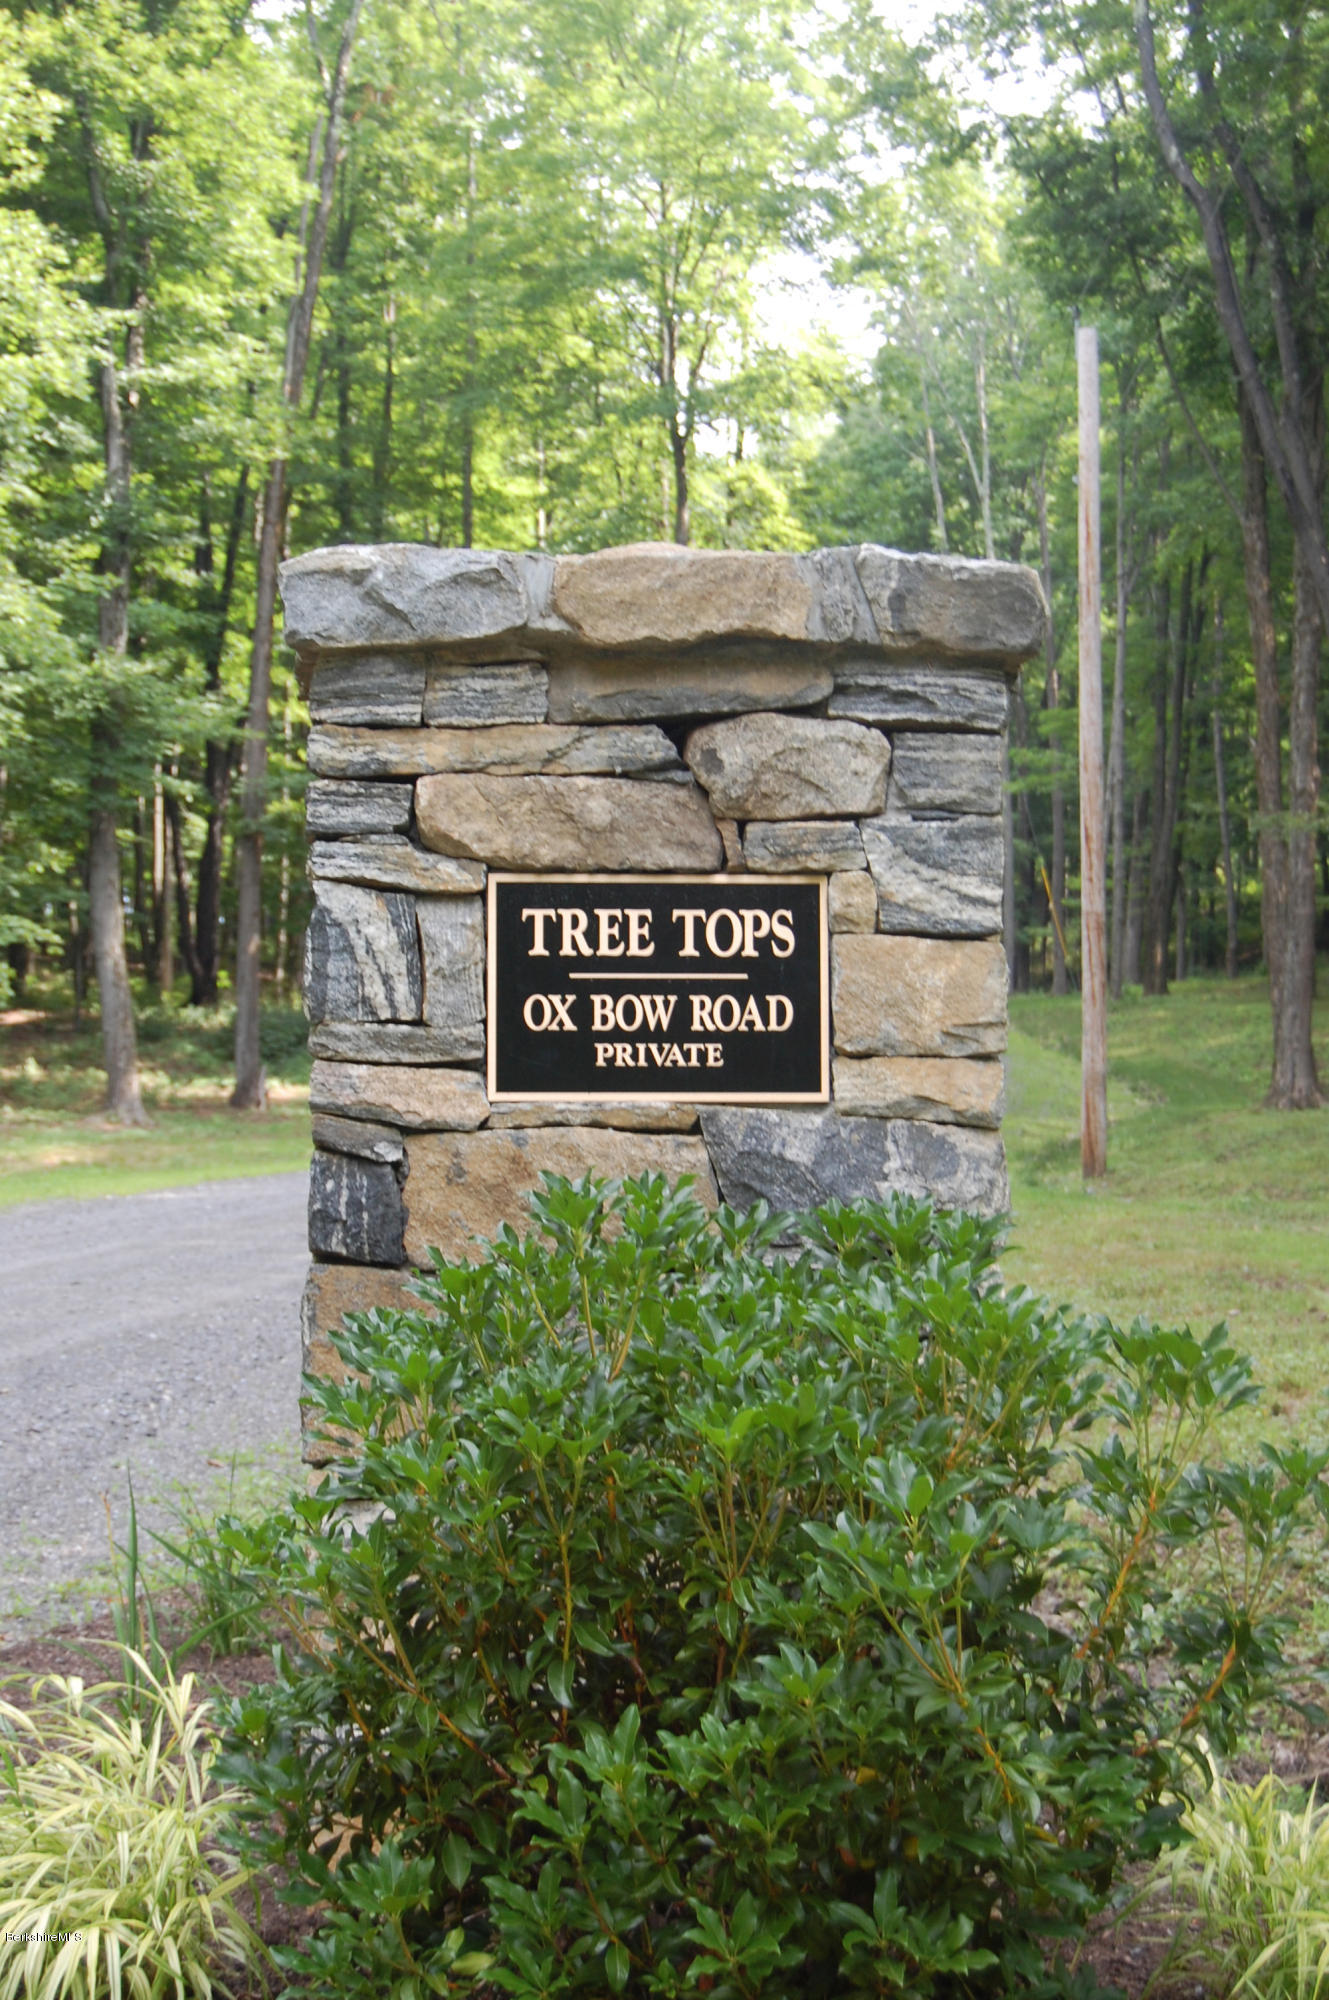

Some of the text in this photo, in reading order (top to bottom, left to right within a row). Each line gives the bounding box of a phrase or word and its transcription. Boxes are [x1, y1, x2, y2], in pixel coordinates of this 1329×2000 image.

[521, 908, 796, 958] TREE TOPS
[523, 994, 794, 1032] OX BOW ROAD
[594, 1043, 724, 1067] PRIVATE
